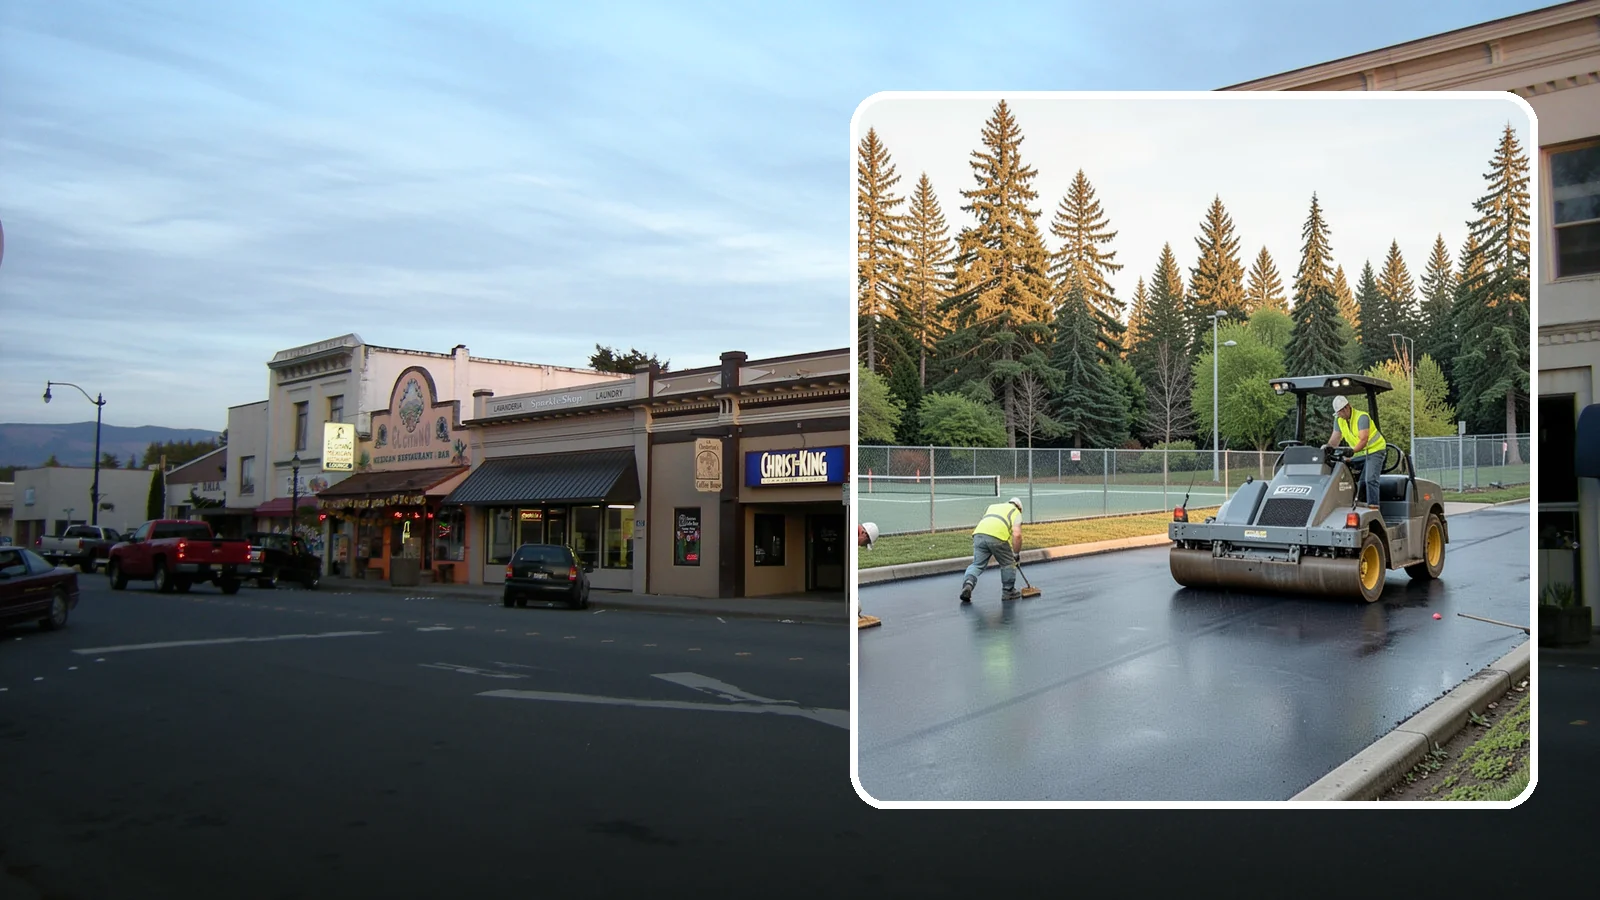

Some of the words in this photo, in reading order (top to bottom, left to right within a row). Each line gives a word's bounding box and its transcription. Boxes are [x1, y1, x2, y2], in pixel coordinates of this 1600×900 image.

[595, 389, 623, 400] LAUNDRY
[493, 402, 524, 413] LAVANDERIA
[530, 397, 562, 409] Sparkle
[562, 394, 583, 406] Shop
[373, 454, 396, 464] MEXICAN
[397, 451, 433, 462] RESTAURANT
[437, 450, 450, 459] BAR
[760, 451, 799, 479] CHRIST
[799, 450, 828, 476] KING
[697, 480, 709, 489] Coffee
